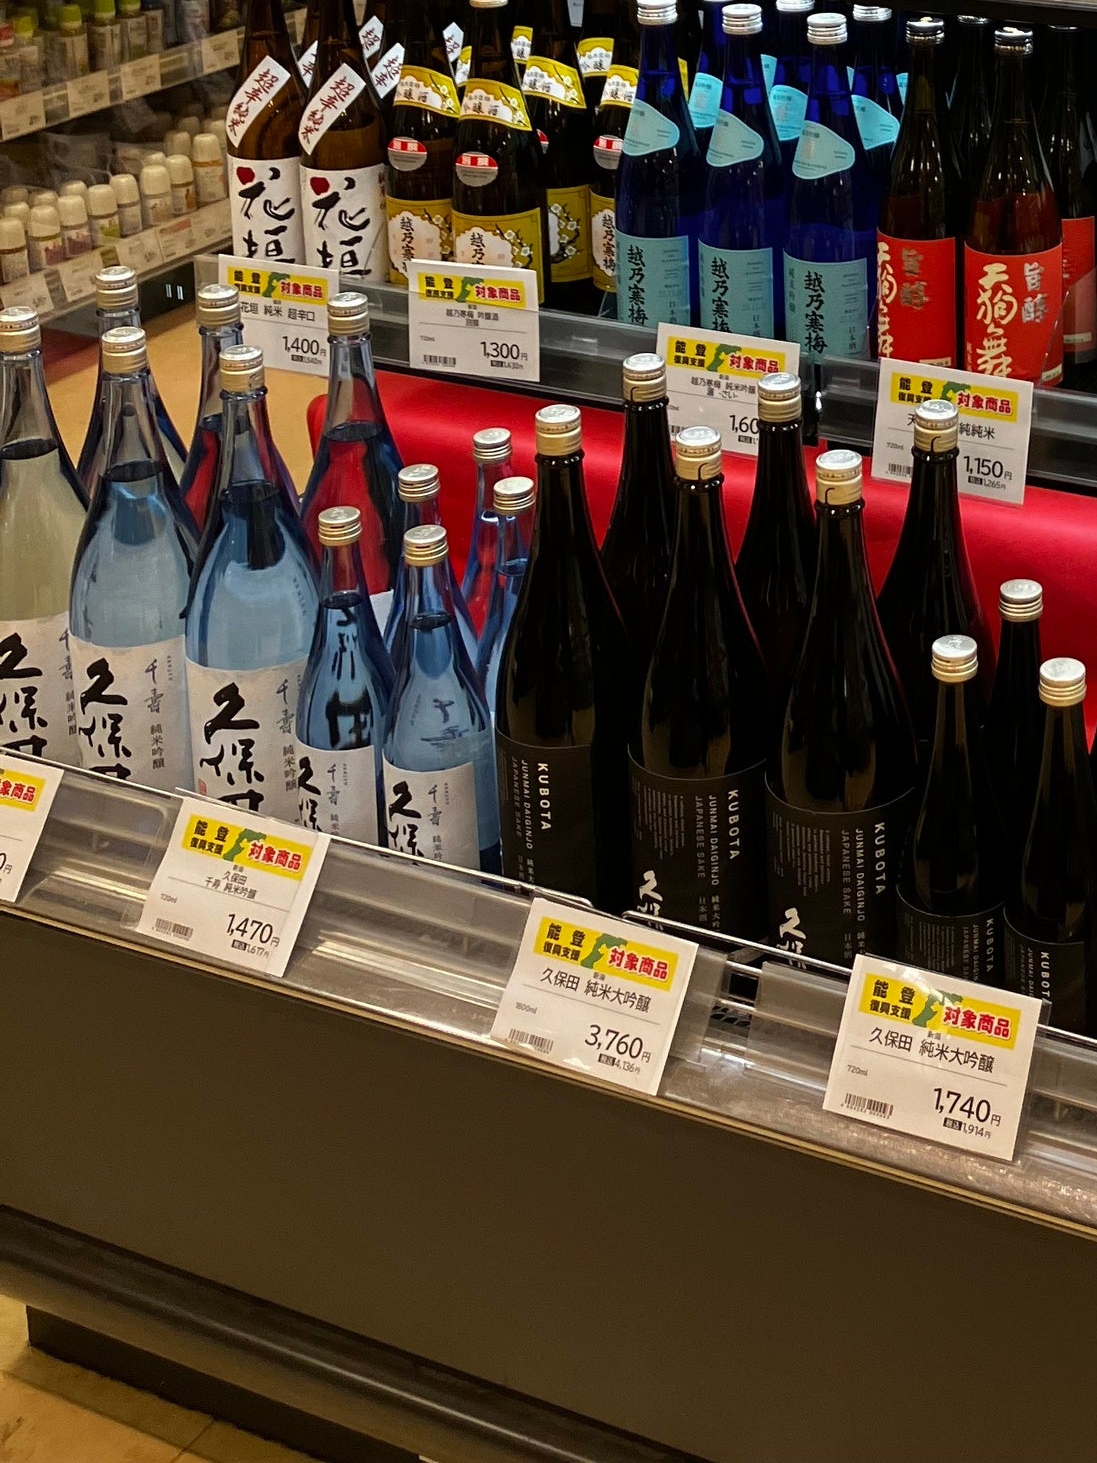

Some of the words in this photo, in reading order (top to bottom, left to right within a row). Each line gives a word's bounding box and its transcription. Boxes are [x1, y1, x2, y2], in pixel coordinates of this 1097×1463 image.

[227, 67, 275, 138] 超辛純米
[300, 75, 355, 145] 超辛純米
[310, 175, 372, 277] 花垣
[626, 245, 648, 326] 越乃寒梅
[263, 302, 283, 317] 純米
[287, 307, 316, 322] 超辛口
[803, 270, 828, 356] 越乃寒梅
[282, 335, 328, 356] 1,400円
[480, 341, 529, 362] 1,300円
[963, 455, 1013, 481] 1,150円
[150, 723, 166, 769] 純米吟醸
[281, 743, 298, 793] 純米吟醸
[521, 759, 530, 796] JUNMAI
[537, 761, 552, 831] KUBOTA
[525, 798, 534, 850] DAIGINJO
[708, 794, 718, 835] JUNMAI
[727, 789, 740, 860] KUBOTA
[222, 870, 248, 886] 久保田
[710, 837, 720, 886] DAIGINJO
[874, 822, 887, 895] KUBOTA
[204, 876, 221, 889] 千寿
[227, 912, 281, 948] 1,470円
[540, 967, 581, 992] 久保田
[584, 979, 652, 1013] 純米大吟醸
[584, 1024, 652, 1064] 3,760円
[942, 1005, 1011, 1039] 対象商品
[847, 1064, 869, 1077] 720ml
[869, 1026, 913, 1052] 久保田
[918, 1039, 996, 1074] 純米大吟醸
[934, 1087, 1002, 1128] 1,740円
